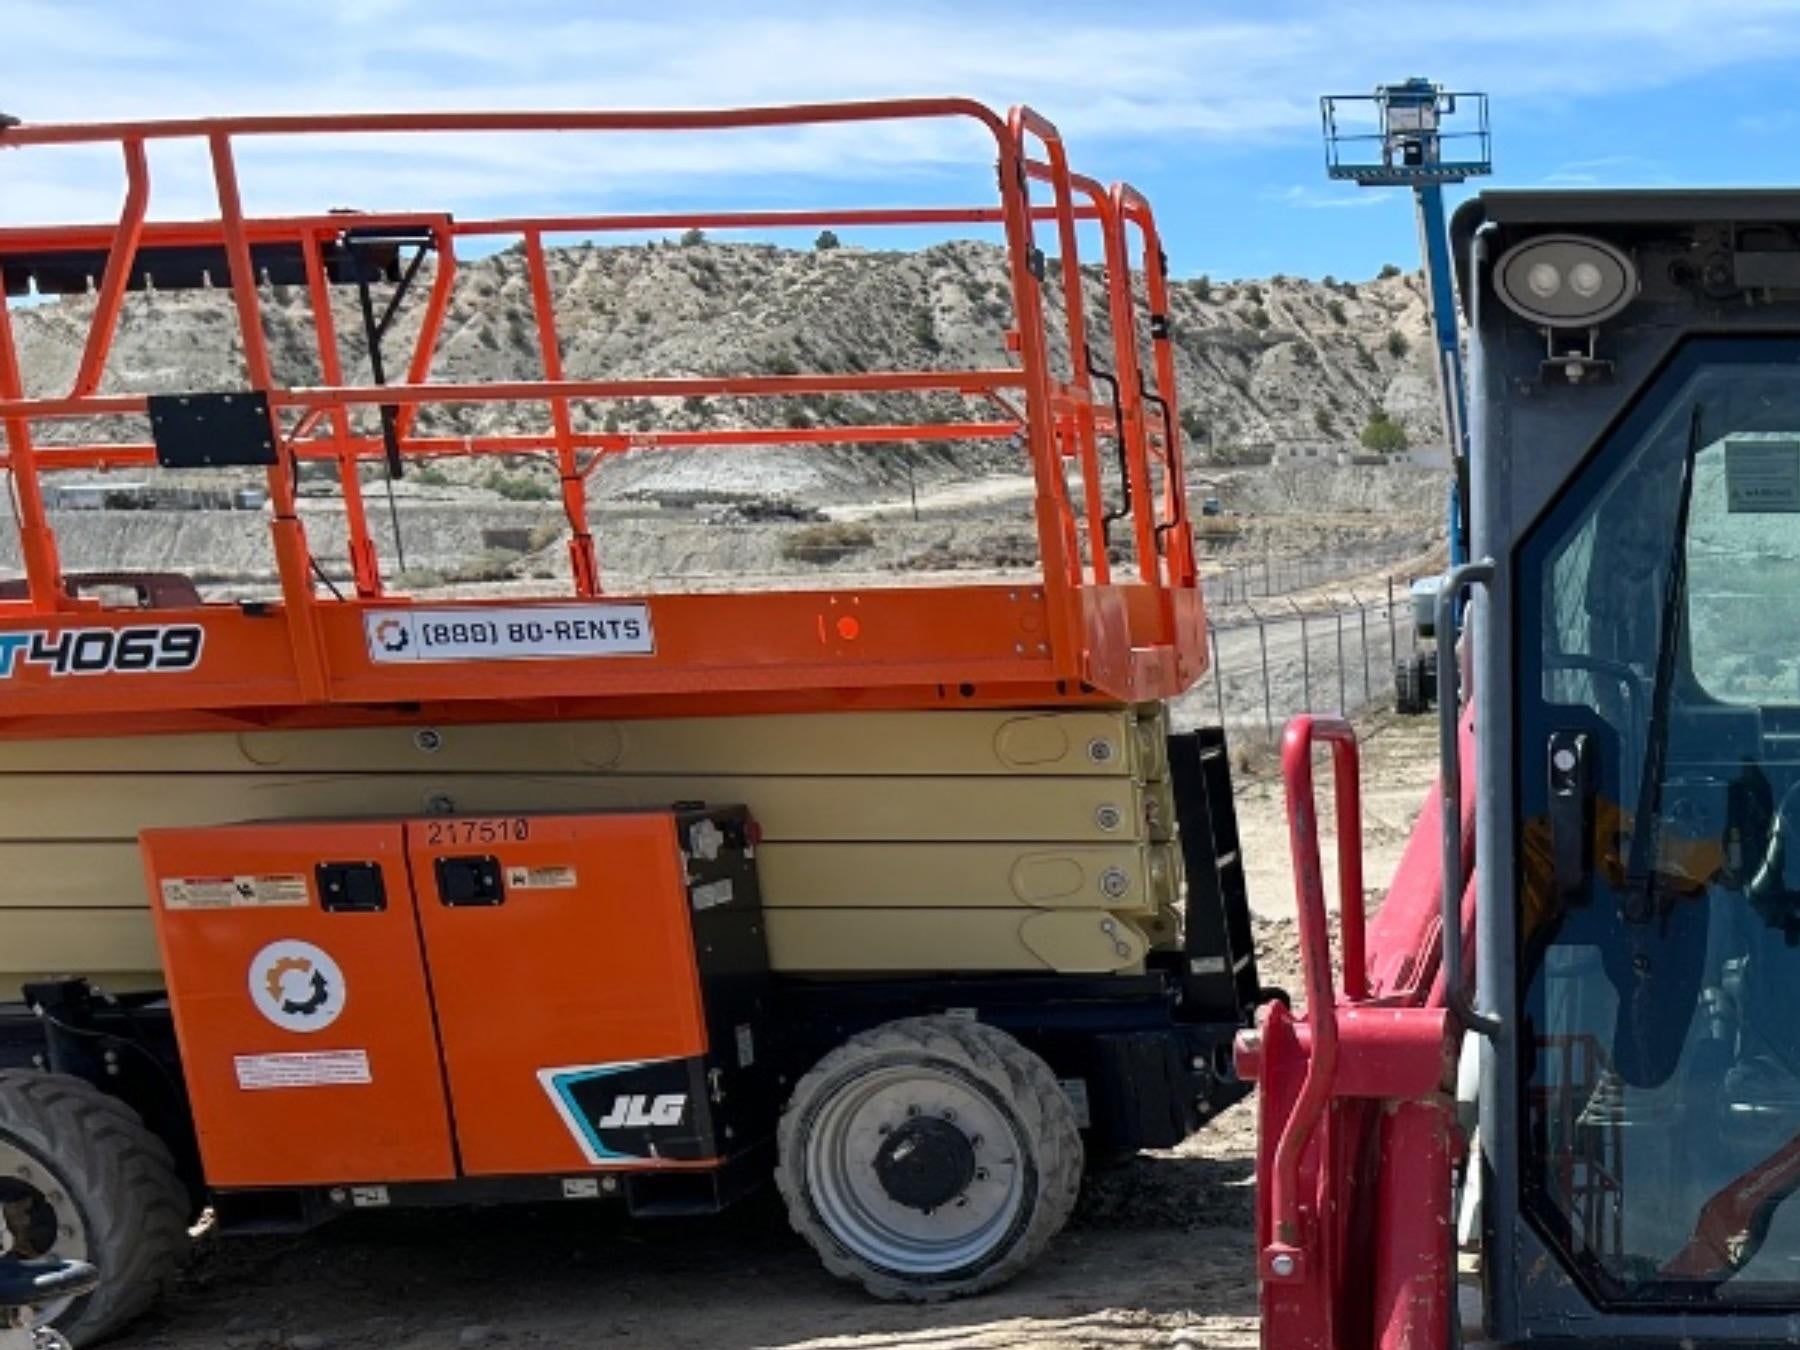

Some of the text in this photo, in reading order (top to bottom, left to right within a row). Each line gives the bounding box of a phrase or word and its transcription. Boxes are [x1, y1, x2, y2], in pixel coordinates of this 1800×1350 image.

[507, 618, 642, 643] 80-RENTS
[427, 818, 530, 845] 217510
[598, 1093, 688, 1129] JLG
